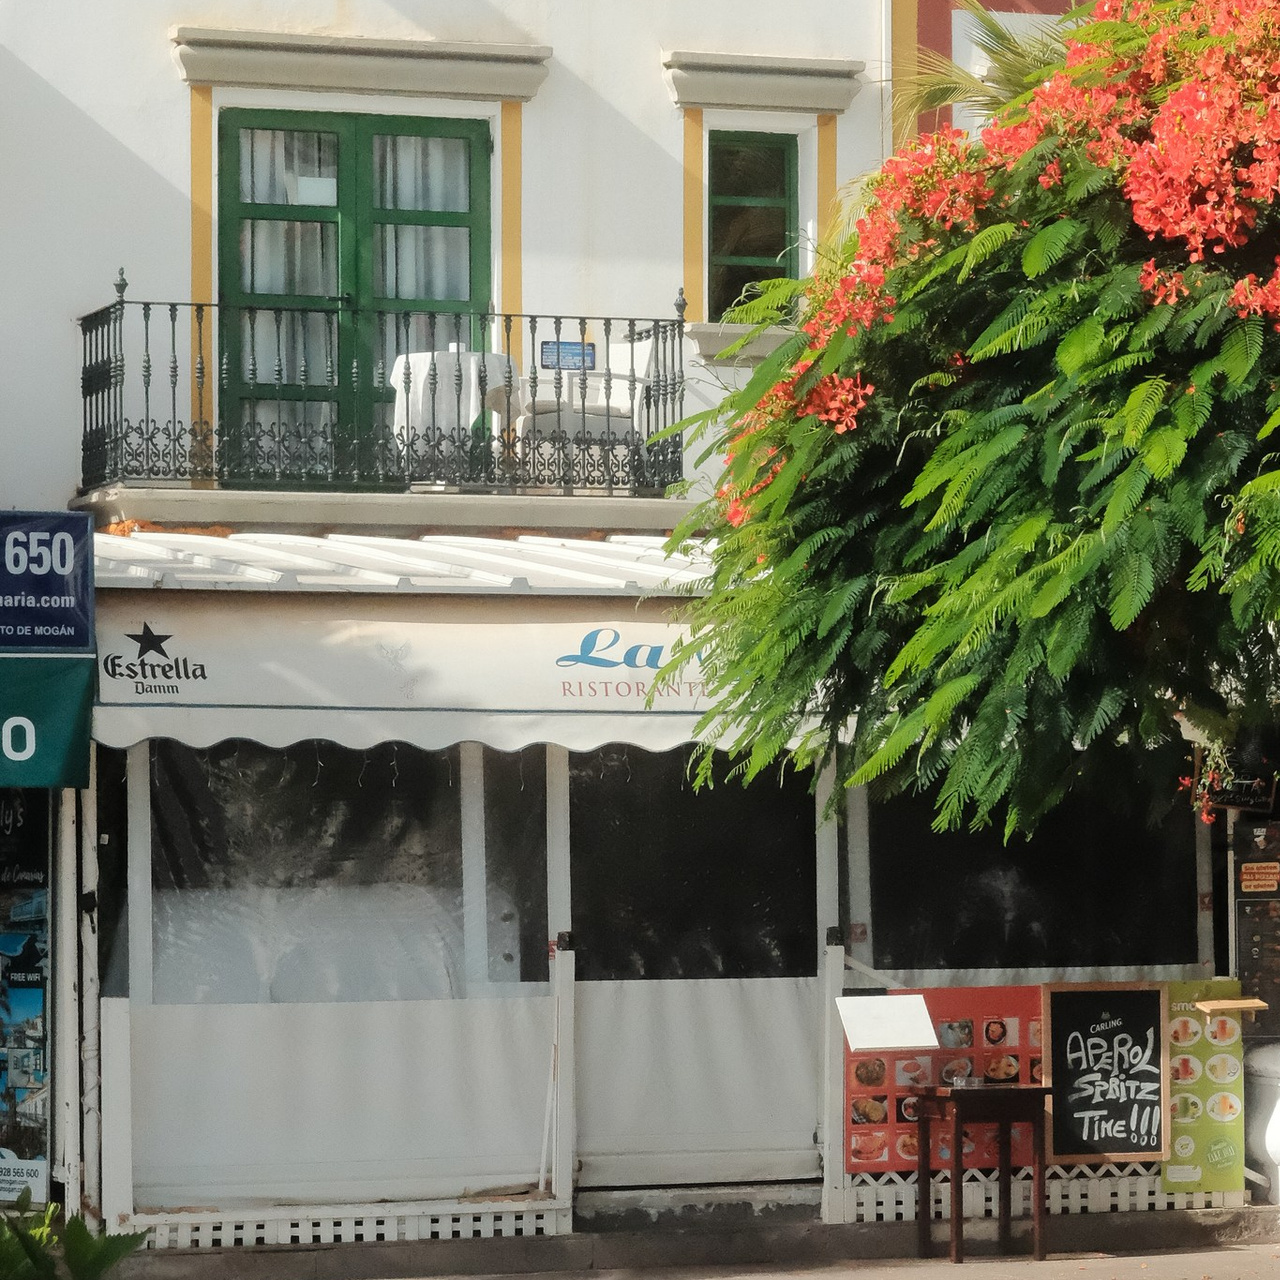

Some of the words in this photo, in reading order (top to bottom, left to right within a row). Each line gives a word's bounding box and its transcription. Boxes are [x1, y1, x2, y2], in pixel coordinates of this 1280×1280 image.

[5, 531, 75, 575] 650
[17, 625, 32, 636] DE
[35, 624, 75, 636] MOGÁN
[556, 628, 665, 670] La
[103, 653, 207, 680] Estrella
[134, 681, 180, 695] Damm
[1089, 1017, 1123, 1034] CARLING
[26, 1168, 39, 1179] 600
